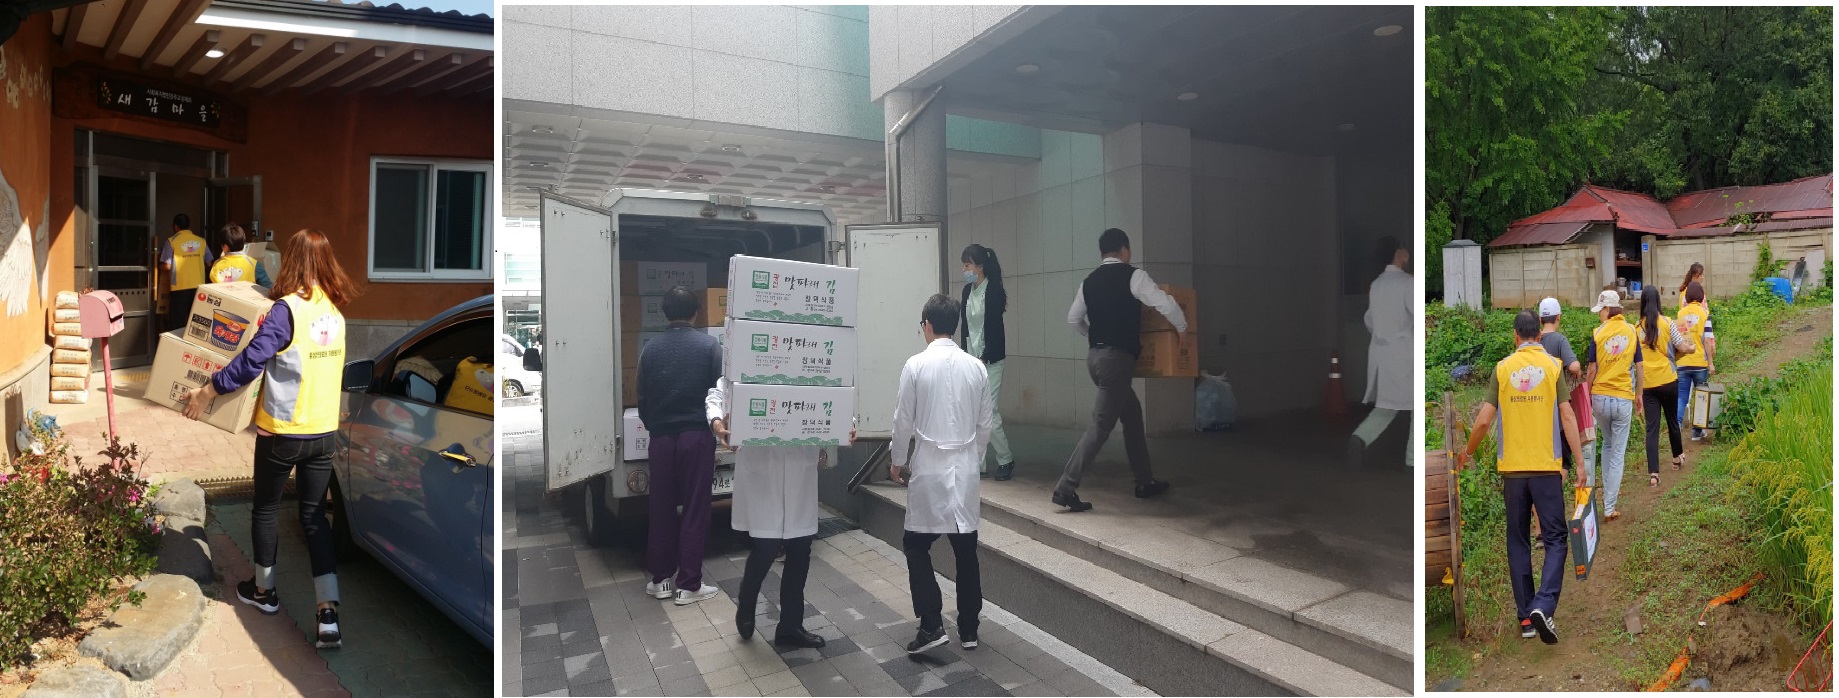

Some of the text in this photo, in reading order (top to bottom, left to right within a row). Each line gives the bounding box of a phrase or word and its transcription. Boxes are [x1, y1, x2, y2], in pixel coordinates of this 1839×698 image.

[825, 279, 836, 294] 김
[823, 340, 834, 356] 김
[822, 400, 833, 417] 김
